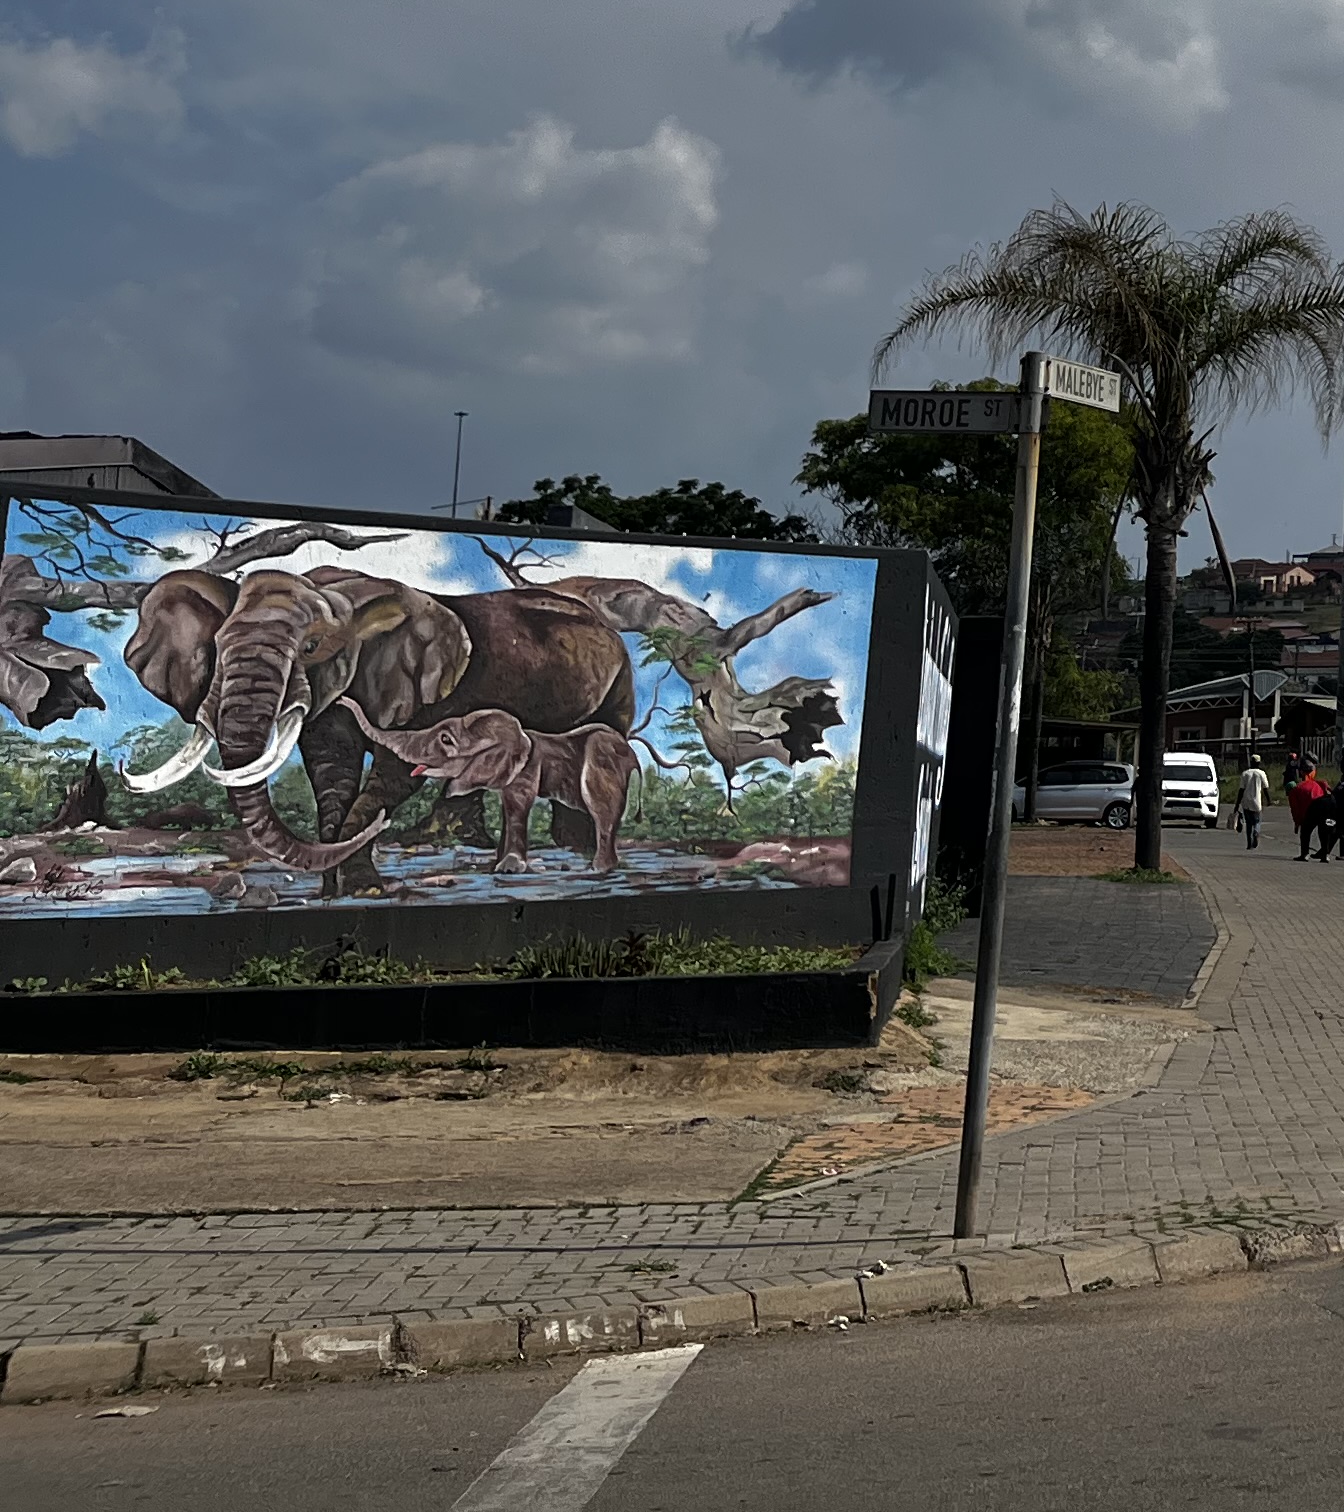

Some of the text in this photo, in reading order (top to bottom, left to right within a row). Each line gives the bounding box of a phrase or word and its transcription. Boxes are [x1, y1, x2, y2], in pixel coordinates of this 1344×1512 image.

[1055, 364, 1117, 402] MALEBYE ST
[880, 398, 1003, 427] MOROE ST
